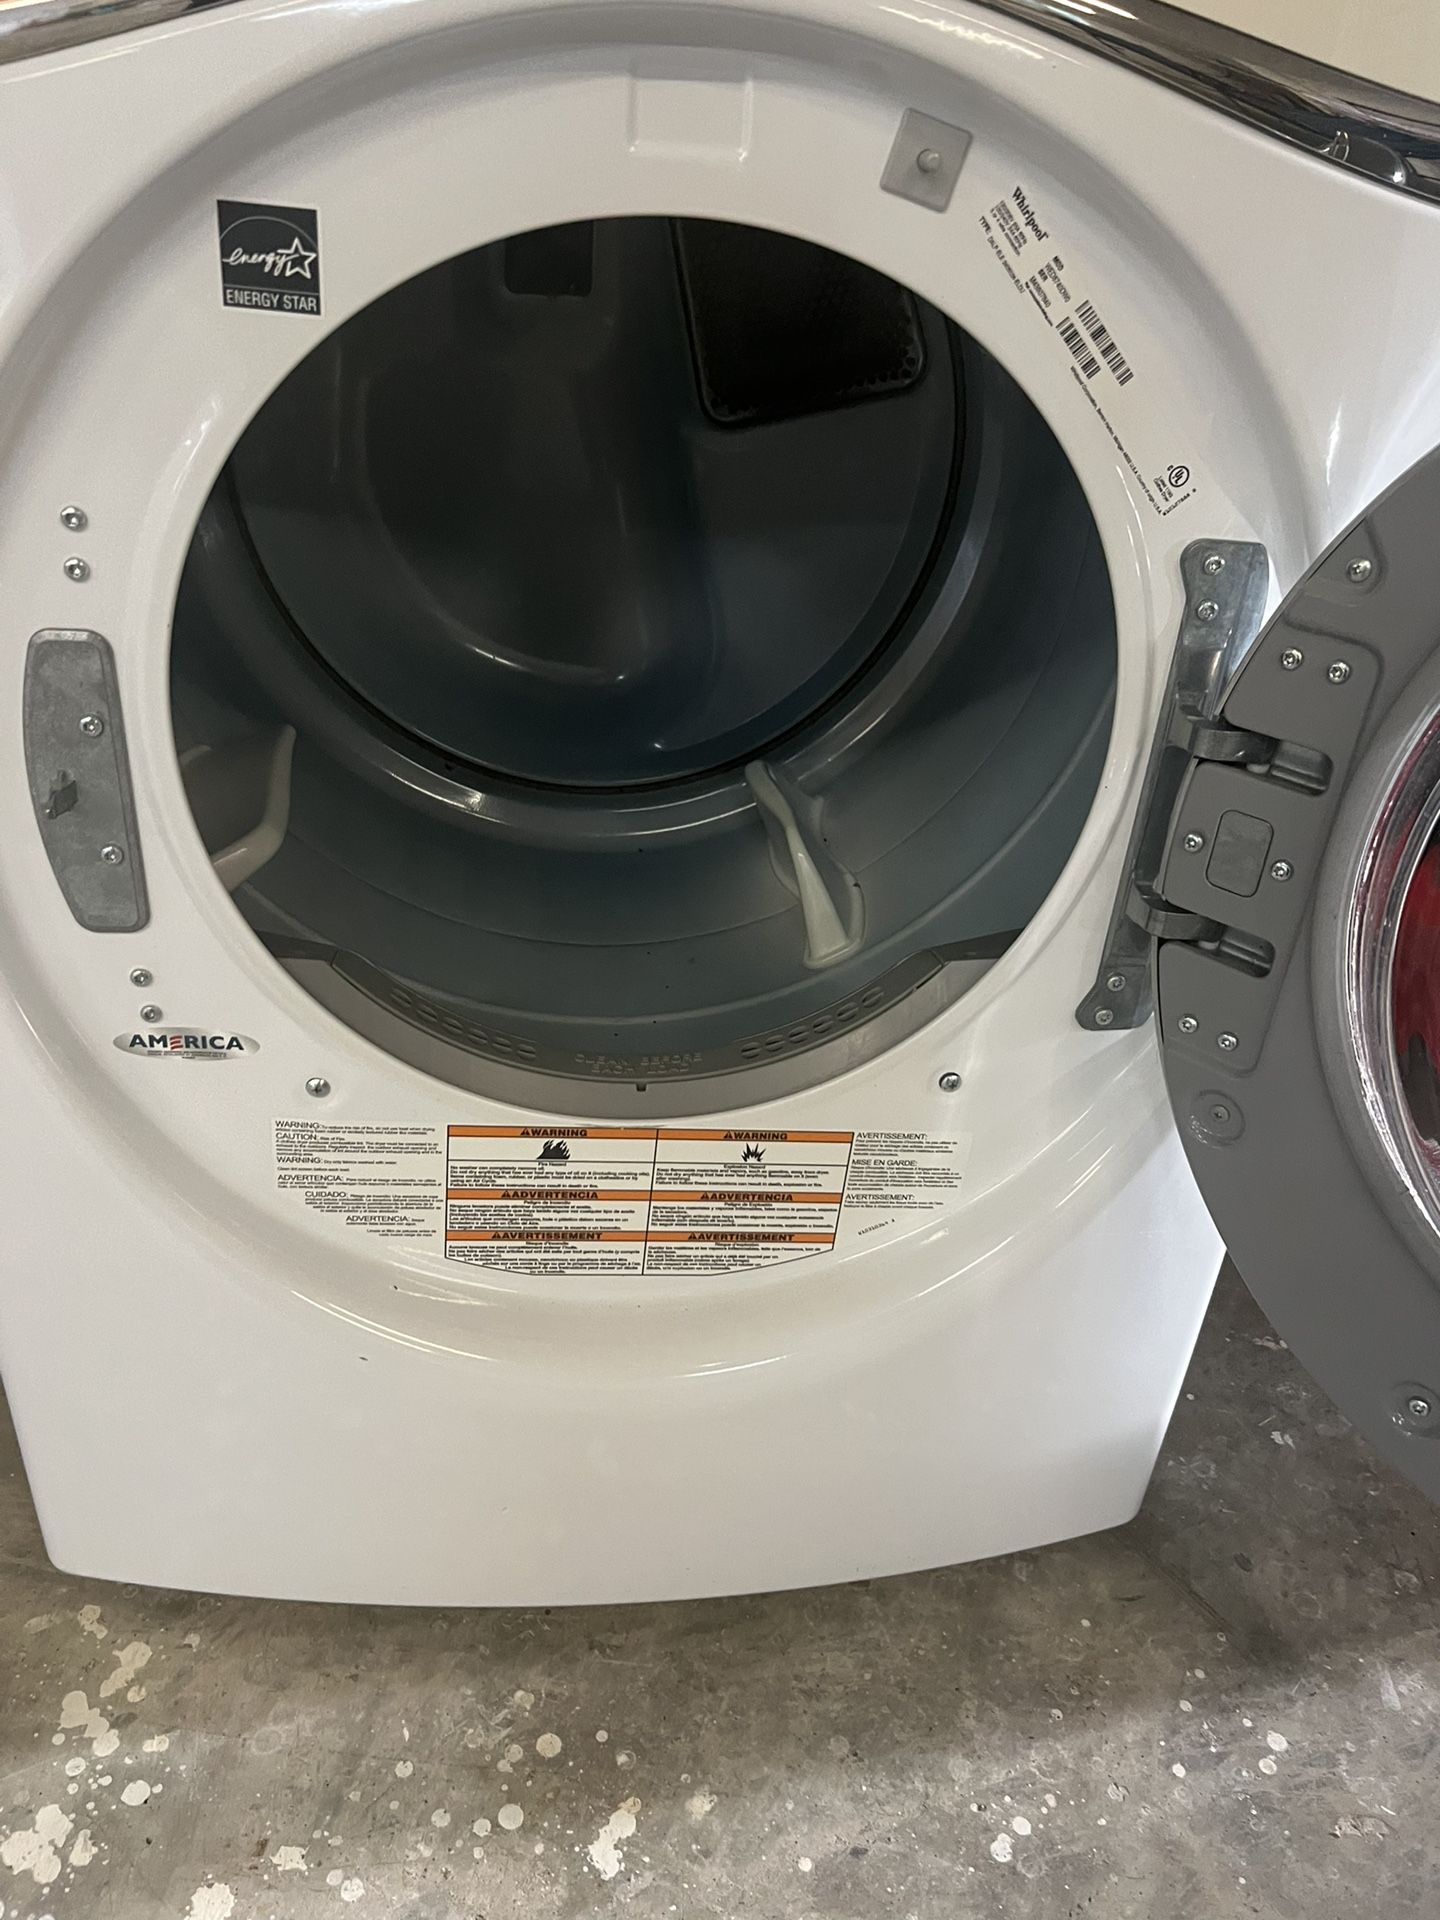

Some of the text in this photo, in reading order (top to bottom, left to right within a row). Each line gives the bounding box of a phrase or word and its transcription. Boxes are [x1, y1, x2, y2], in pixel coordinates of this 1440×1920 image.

[1012, 185, 1048, 241] Whirlpool
[222, 247, 298, 277] energy
[226, 289, 317, 312] ENERGY STAR
[129, 1034, 244, 1050] AMERICA
[275, 1120, 322, 1129] WARNING:
[531, 1129, 587, 1137] WARNING
[733, 1132, 787, 1140] WARNING
[857, 1132, 928, 1140] AVERTISSEMENT:
[513, 1191, 599, 1199] ADVERTENCIA
[711, 1193, 793, 1201] ADVERTENCIA
[700, 1234, 795, 1242] AVERTISSEMENT
